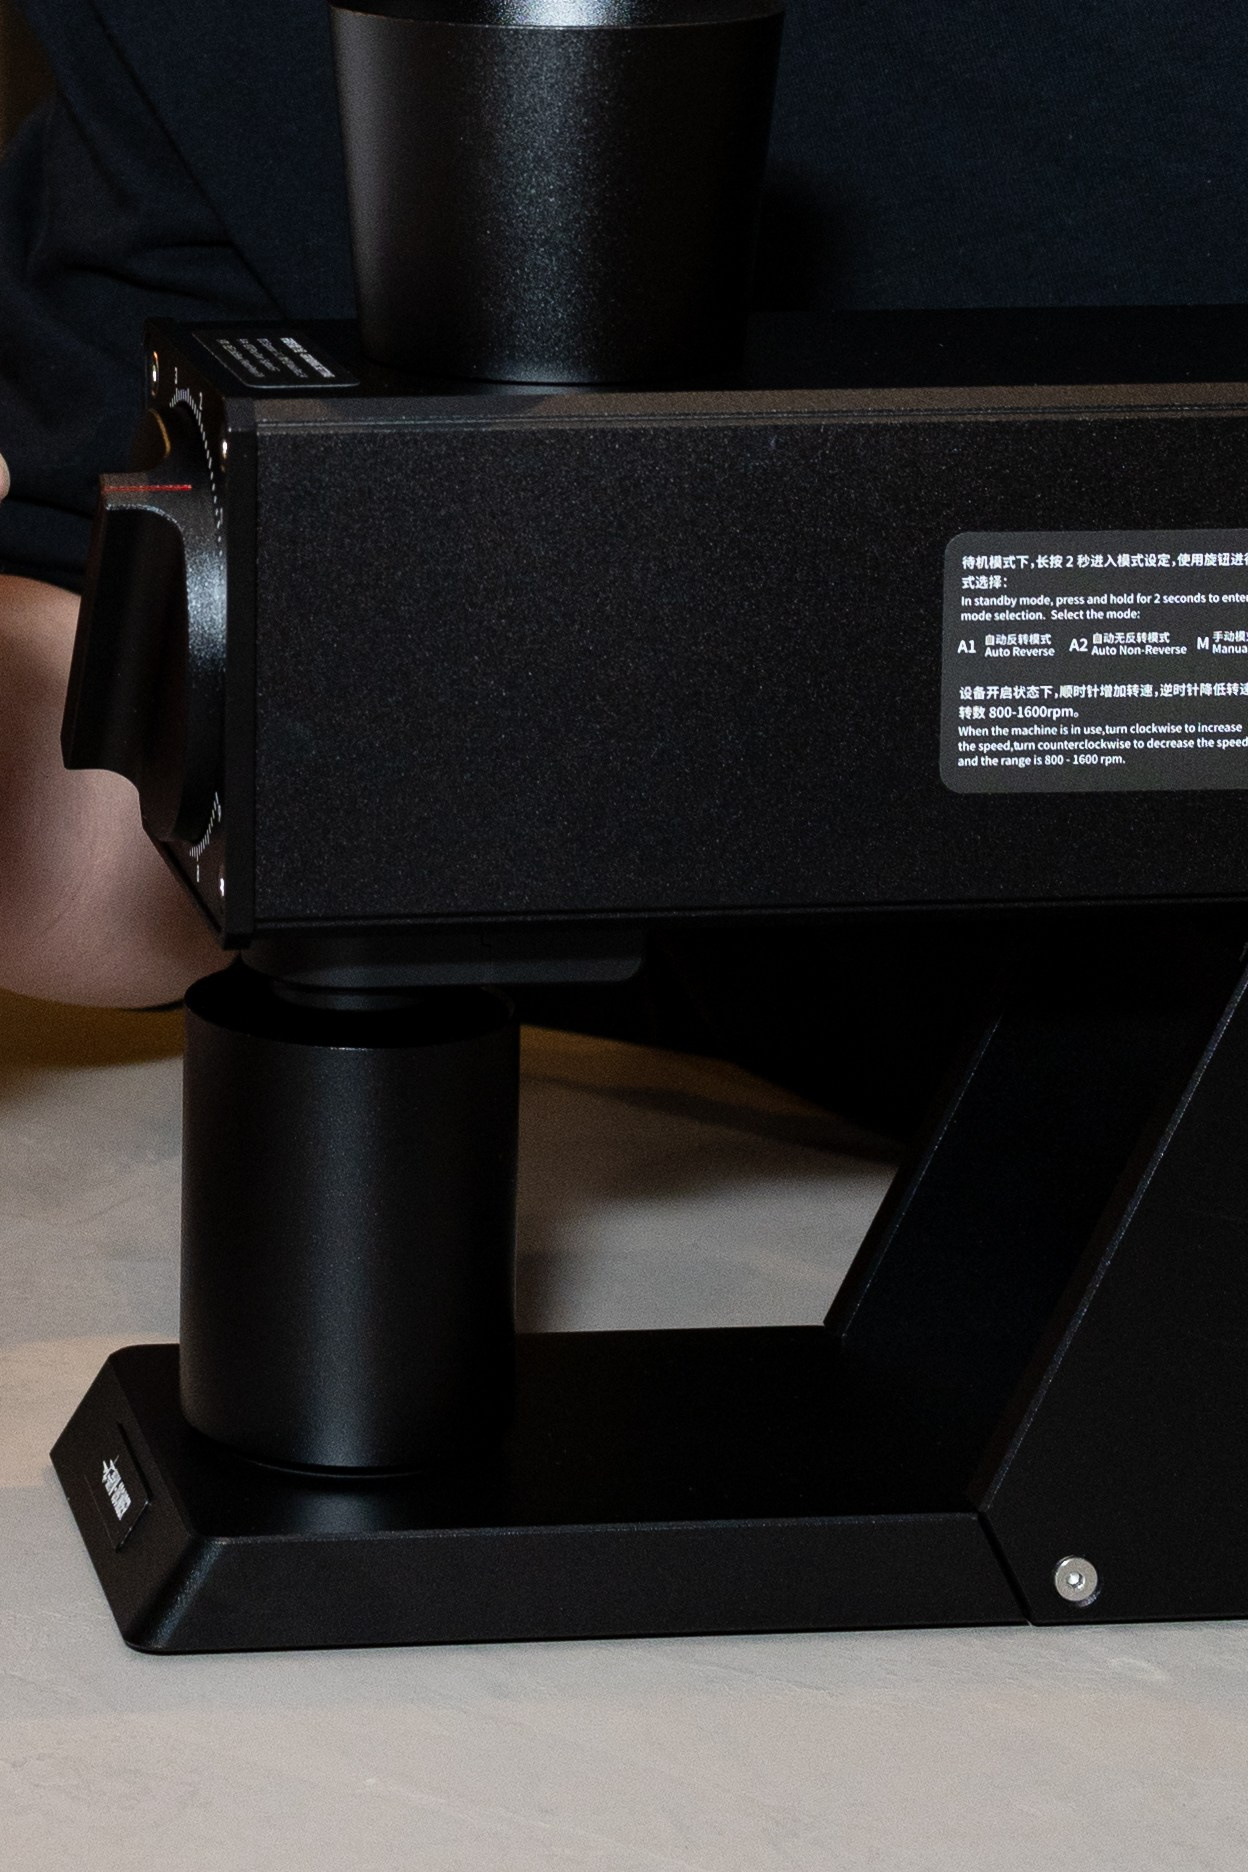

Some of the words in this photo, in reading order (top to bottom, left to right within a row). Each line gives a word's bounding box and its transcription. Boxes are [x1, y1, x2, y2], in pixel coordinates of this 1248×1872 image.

[1066, 555, 1073, 567] 2
[961, 596, 972, 606] In
[974, 595, 1017, 607] standby
[1019, 595, 1054, 606] mode,
[1056, 596, 1085, 607] press
[1087, 594, 1108, 605] and
[1110, 593, 1134, 604] hold
[1136, 593, 1152, 604] for
[1154, 594, 1161, 604] 2
[1163, 592, 1206, 603] seconds
[1208, 593, 1220, 603] to
[961, 610, 992, 621] mode
[994, 609, 1046, 621] selection.
[1051, 609, 1083, 620] Select
[1086, 608, 1104, 619] the
[1106, 608, 1140, 619] mode:
[985, 633, 1052, 646] 自动反转模式
[1092, 632, 1170, 645] 自动无反转模式
[1197, 636, 1210, 650] M
[1212, 630, 1248, 643] 手动模
[957, 640, 976, 653] A1
[985, 646, 1010, 657] Auto
[1013, 646, 1055, 657] Reverse
[1069, 638, 1088, 652] A2
[1091, 645, 1117, 656] Auto
[1119, 644, 1187, 656] Non-Reverse
[959, 706, 986, 720] 转数
[958, 725, 989, 736] When
[991, 725, 1010, 736] the
[1012, 724, 1057, 735] machine
[1060, 724, 1069, 735] is
[1071, 724, 1081, 734] in
[1130, 723, 1182, 734] clockwise
[1184, 723, 1196, 733] to
[1198, 722, 1242, 732] increase
[958, 741, 976, 752] the
[1037, 739, 1131, 750] counterclockwise
[1133, 739, 1145, 749] to
[1147, 737, 1195, 748] decrease
[1197, 737, 1215, 748] the
[958, 756, 979, 767] and
[981, 755, 999, 766] the
[1001, 756, 1032, 768] range
[1034, 754, 1043, 765] is
[1044, 754, 1064, 765] 800
[1073, 754, 1099, 765] 1600
[1100, 753, 1126, 767] rpm.
